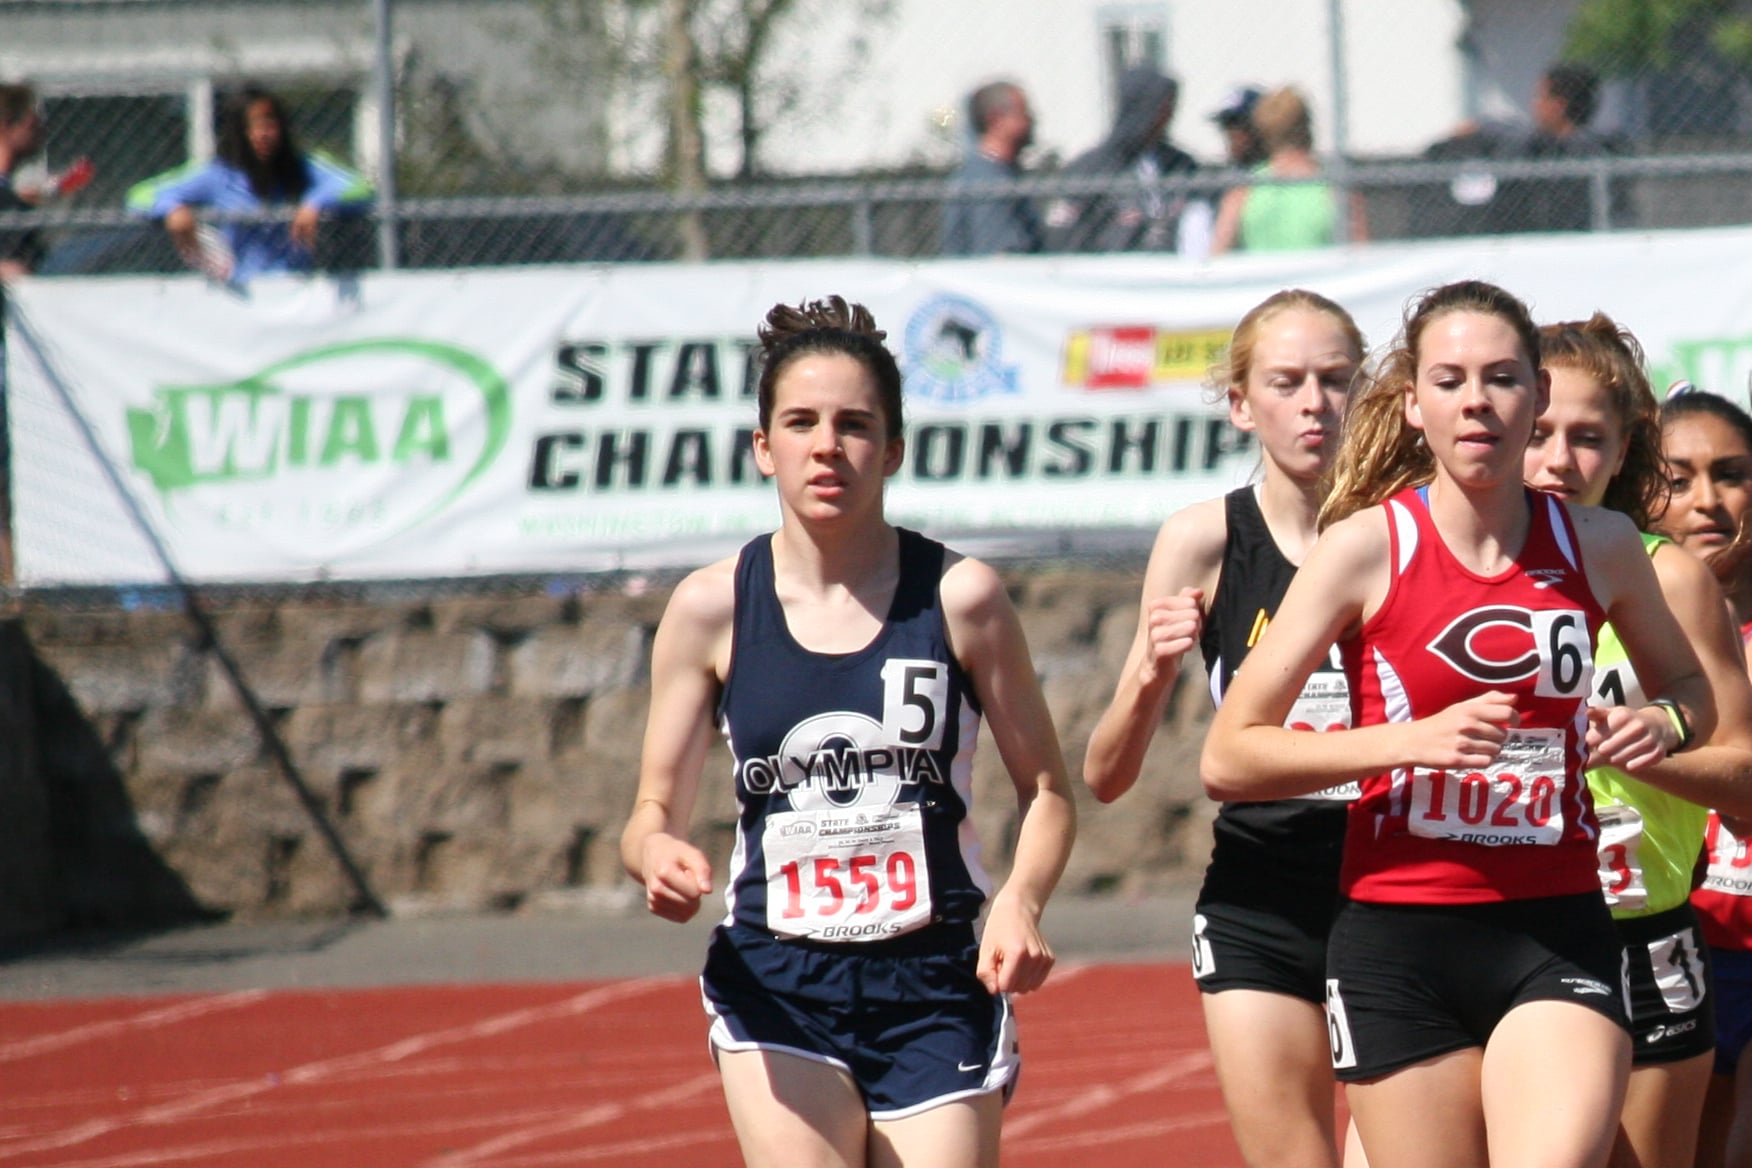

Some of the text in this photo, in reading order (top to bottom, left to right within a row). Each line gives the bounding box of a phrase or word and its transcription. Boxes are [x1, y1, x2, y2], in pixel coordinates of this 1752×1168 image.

[552, 342, 764, 402] STAT
[196, 392, 450, 474] WIAA
[1550, 614, 1583, 694] 6
[900, 666, 937, 744] 5
[743, 747, 945, 795] OLYMPIA
[1460, 833, 1537, 846] BROOKS
[779, 851, 917, 920] 1559
[822, 921, 902, 938] BROOKS
